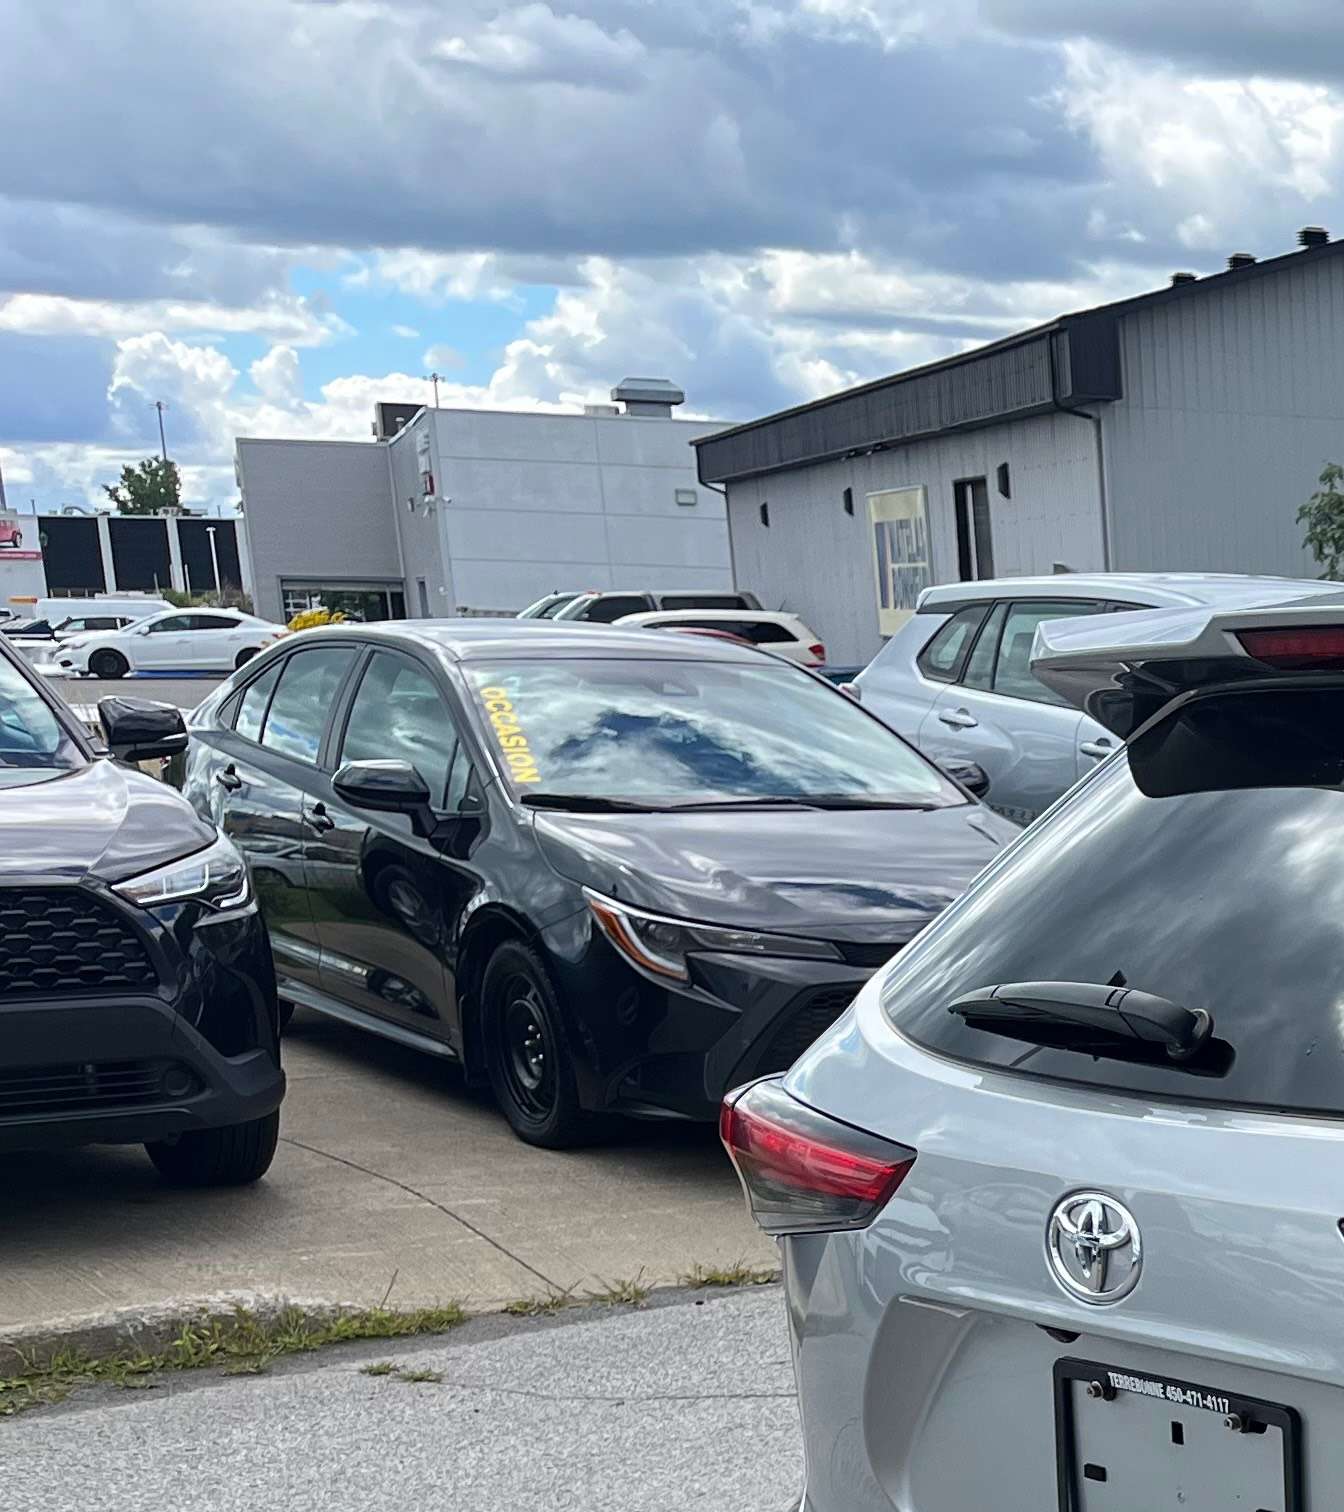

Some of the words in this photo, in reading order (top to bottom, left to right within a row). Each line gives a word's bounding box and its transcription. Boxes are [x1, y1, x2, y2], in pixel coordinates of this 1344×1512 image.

[480, 687, 541, 782] OCCASION
[1107, 1371, 1165, 1398] TERREBONNE
[1166, 1385, 1229, 1414] 450-471-4117
